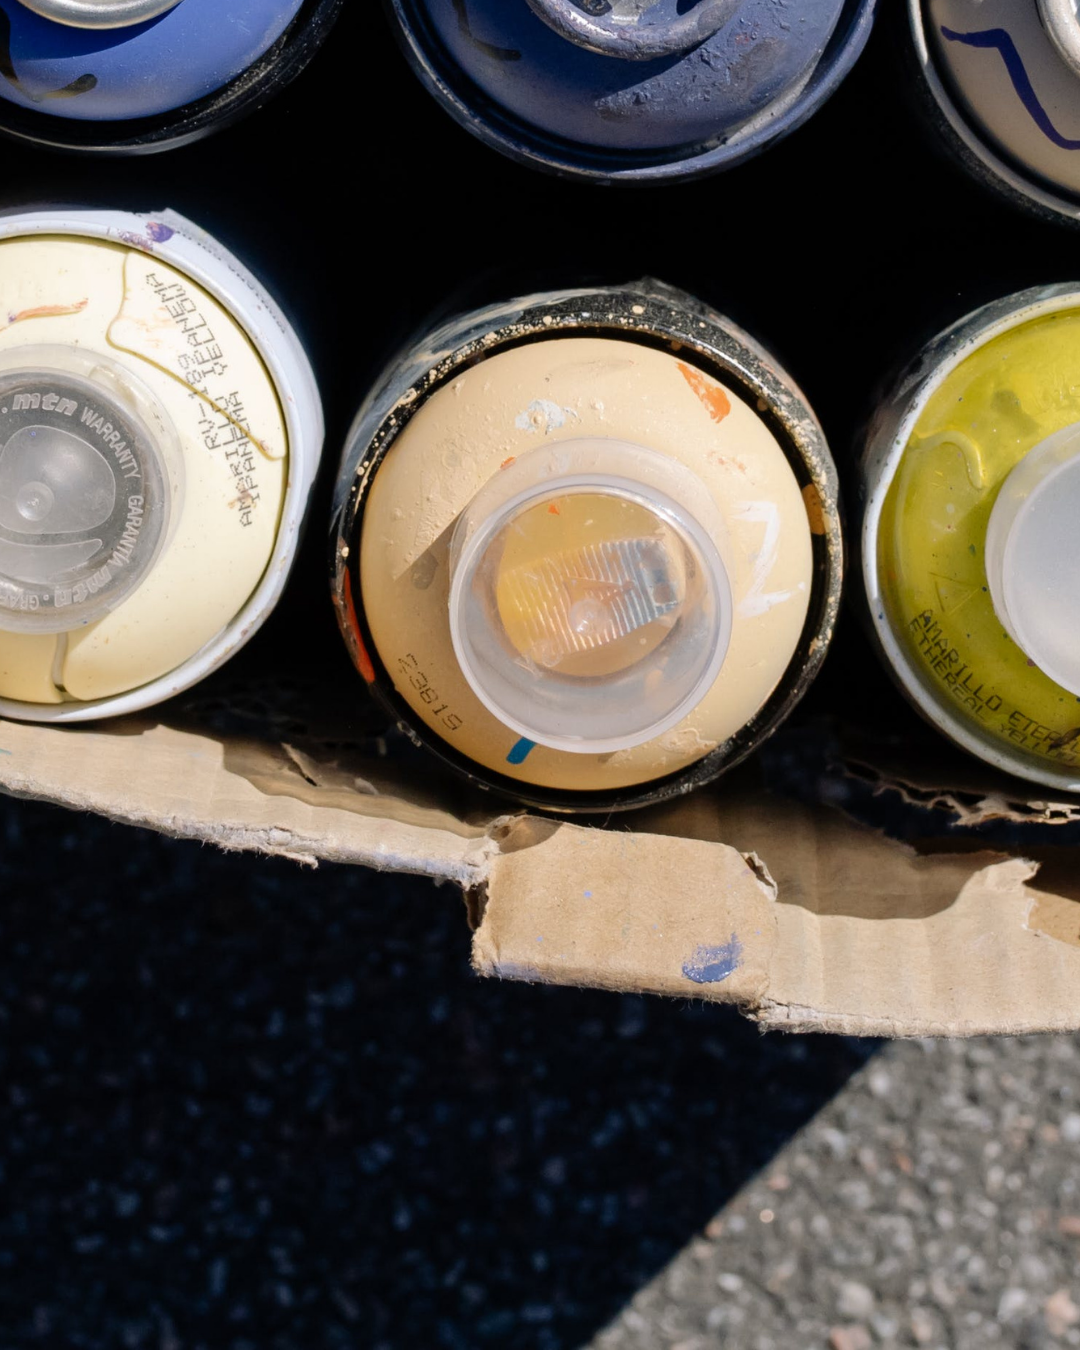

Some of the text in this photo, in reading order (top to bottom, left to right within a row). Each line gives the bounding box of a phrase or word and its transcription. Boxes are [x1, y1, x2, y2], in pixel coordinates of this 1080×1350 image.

[146, 273, 216, 378] IPANEMA
[168, 283, 228, 376] YELLOW
[12, 392, 80, 416] mtn
[80, 407, 142, 479] WARRANTY
[228, 391, 261, 504] IPANEMA
[210, 396, 253, 527] AMARILLO
[54, 569, 113, 609] mtn
[909, 617, 988, 721] ETHEREAL
[919, 609, 1003, 712] AMARILLO
